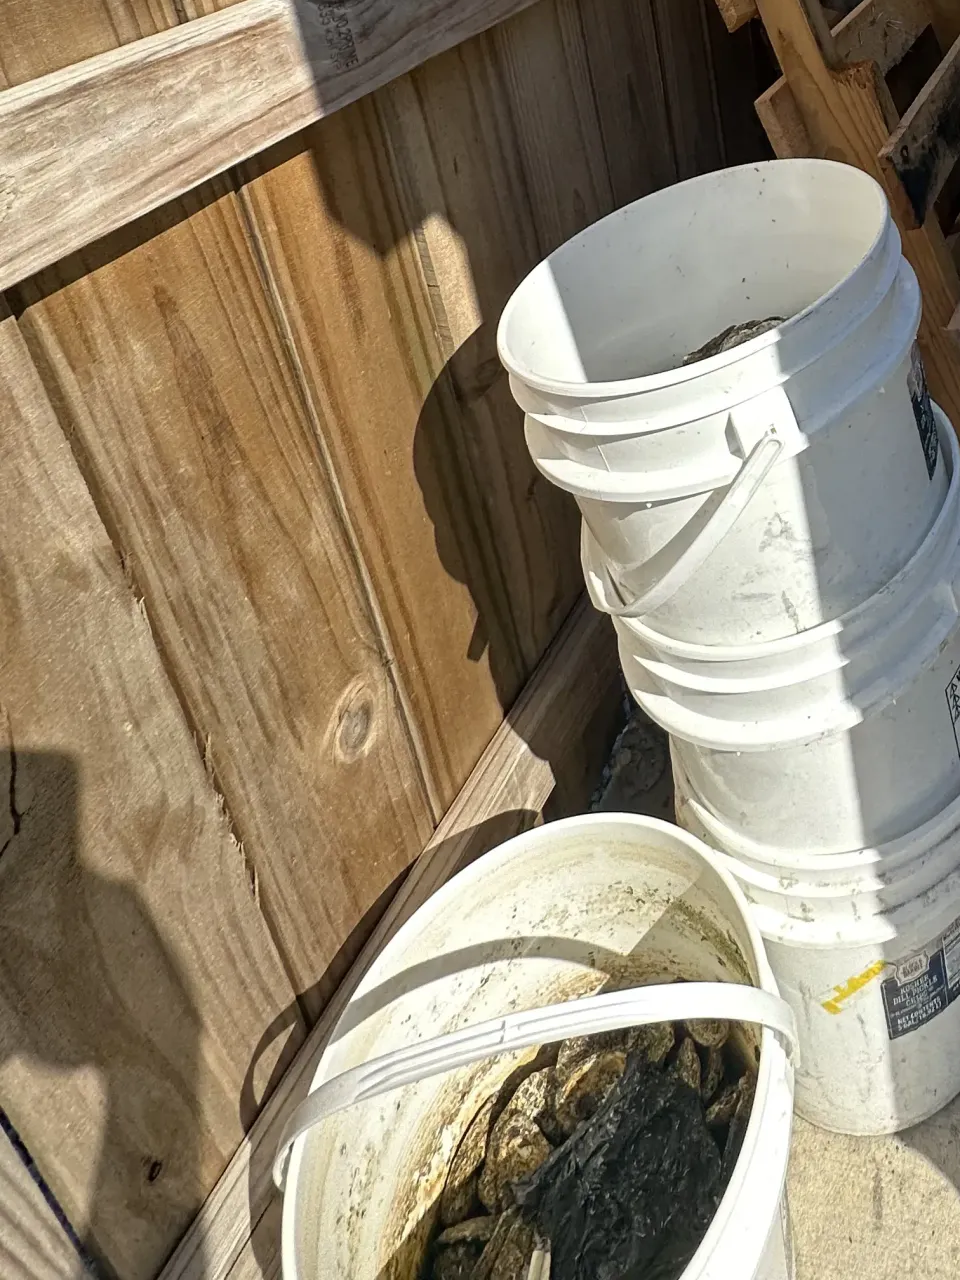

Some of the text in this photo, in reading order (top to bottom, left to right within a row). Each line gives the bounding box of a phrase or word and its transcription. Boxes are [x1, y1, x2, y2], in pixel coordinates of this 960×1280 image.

[893, 992, 910, 1006] DILL
[912, 974, 938, 997] PICKLE
[900, 973, 929, 995] KOSHER
[898, 1014, 909, 1026] NET
[910, 995, 941, 1018] CONTENTS
